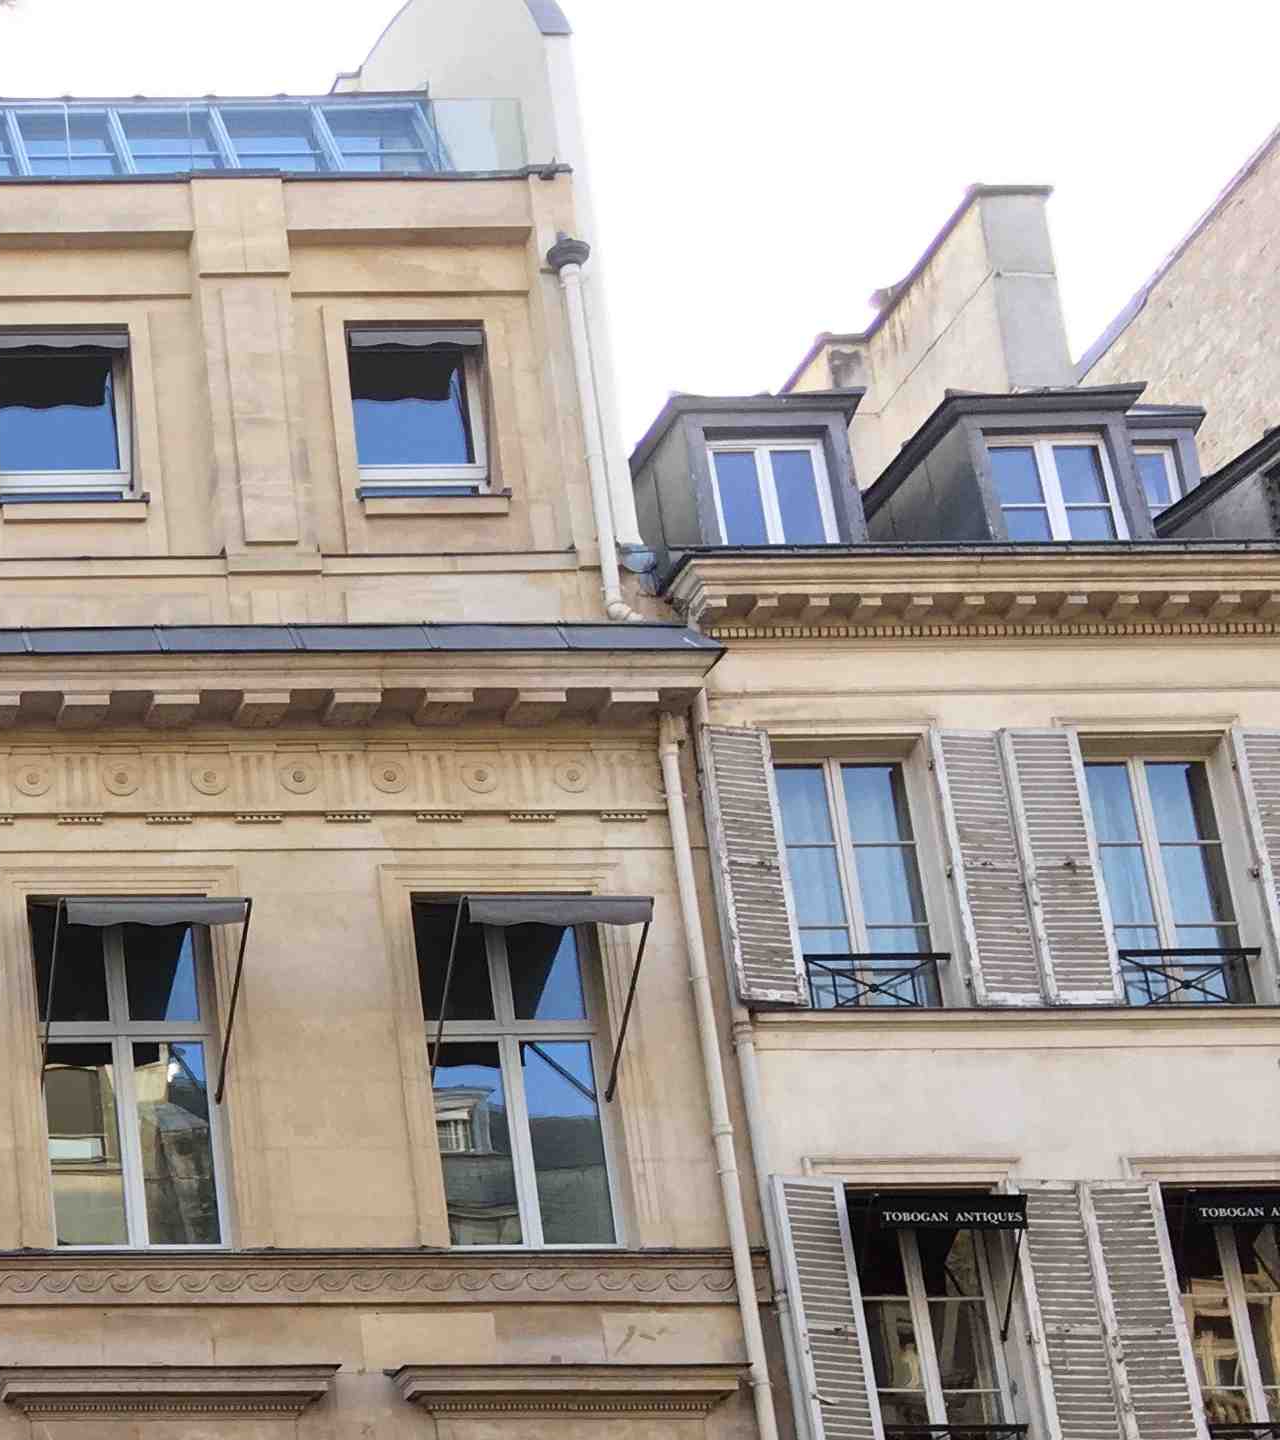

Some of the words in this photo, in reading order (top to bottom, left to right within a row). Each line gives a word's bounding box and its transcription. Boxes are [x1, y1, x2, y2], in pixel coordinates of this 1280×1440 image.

[883, 1211, 948, 1223] TOBOGAN
[955, 1211, 1023, 1224] ANTIQUES
[1199, 1207, 1265, 1218] TOBOGAN
